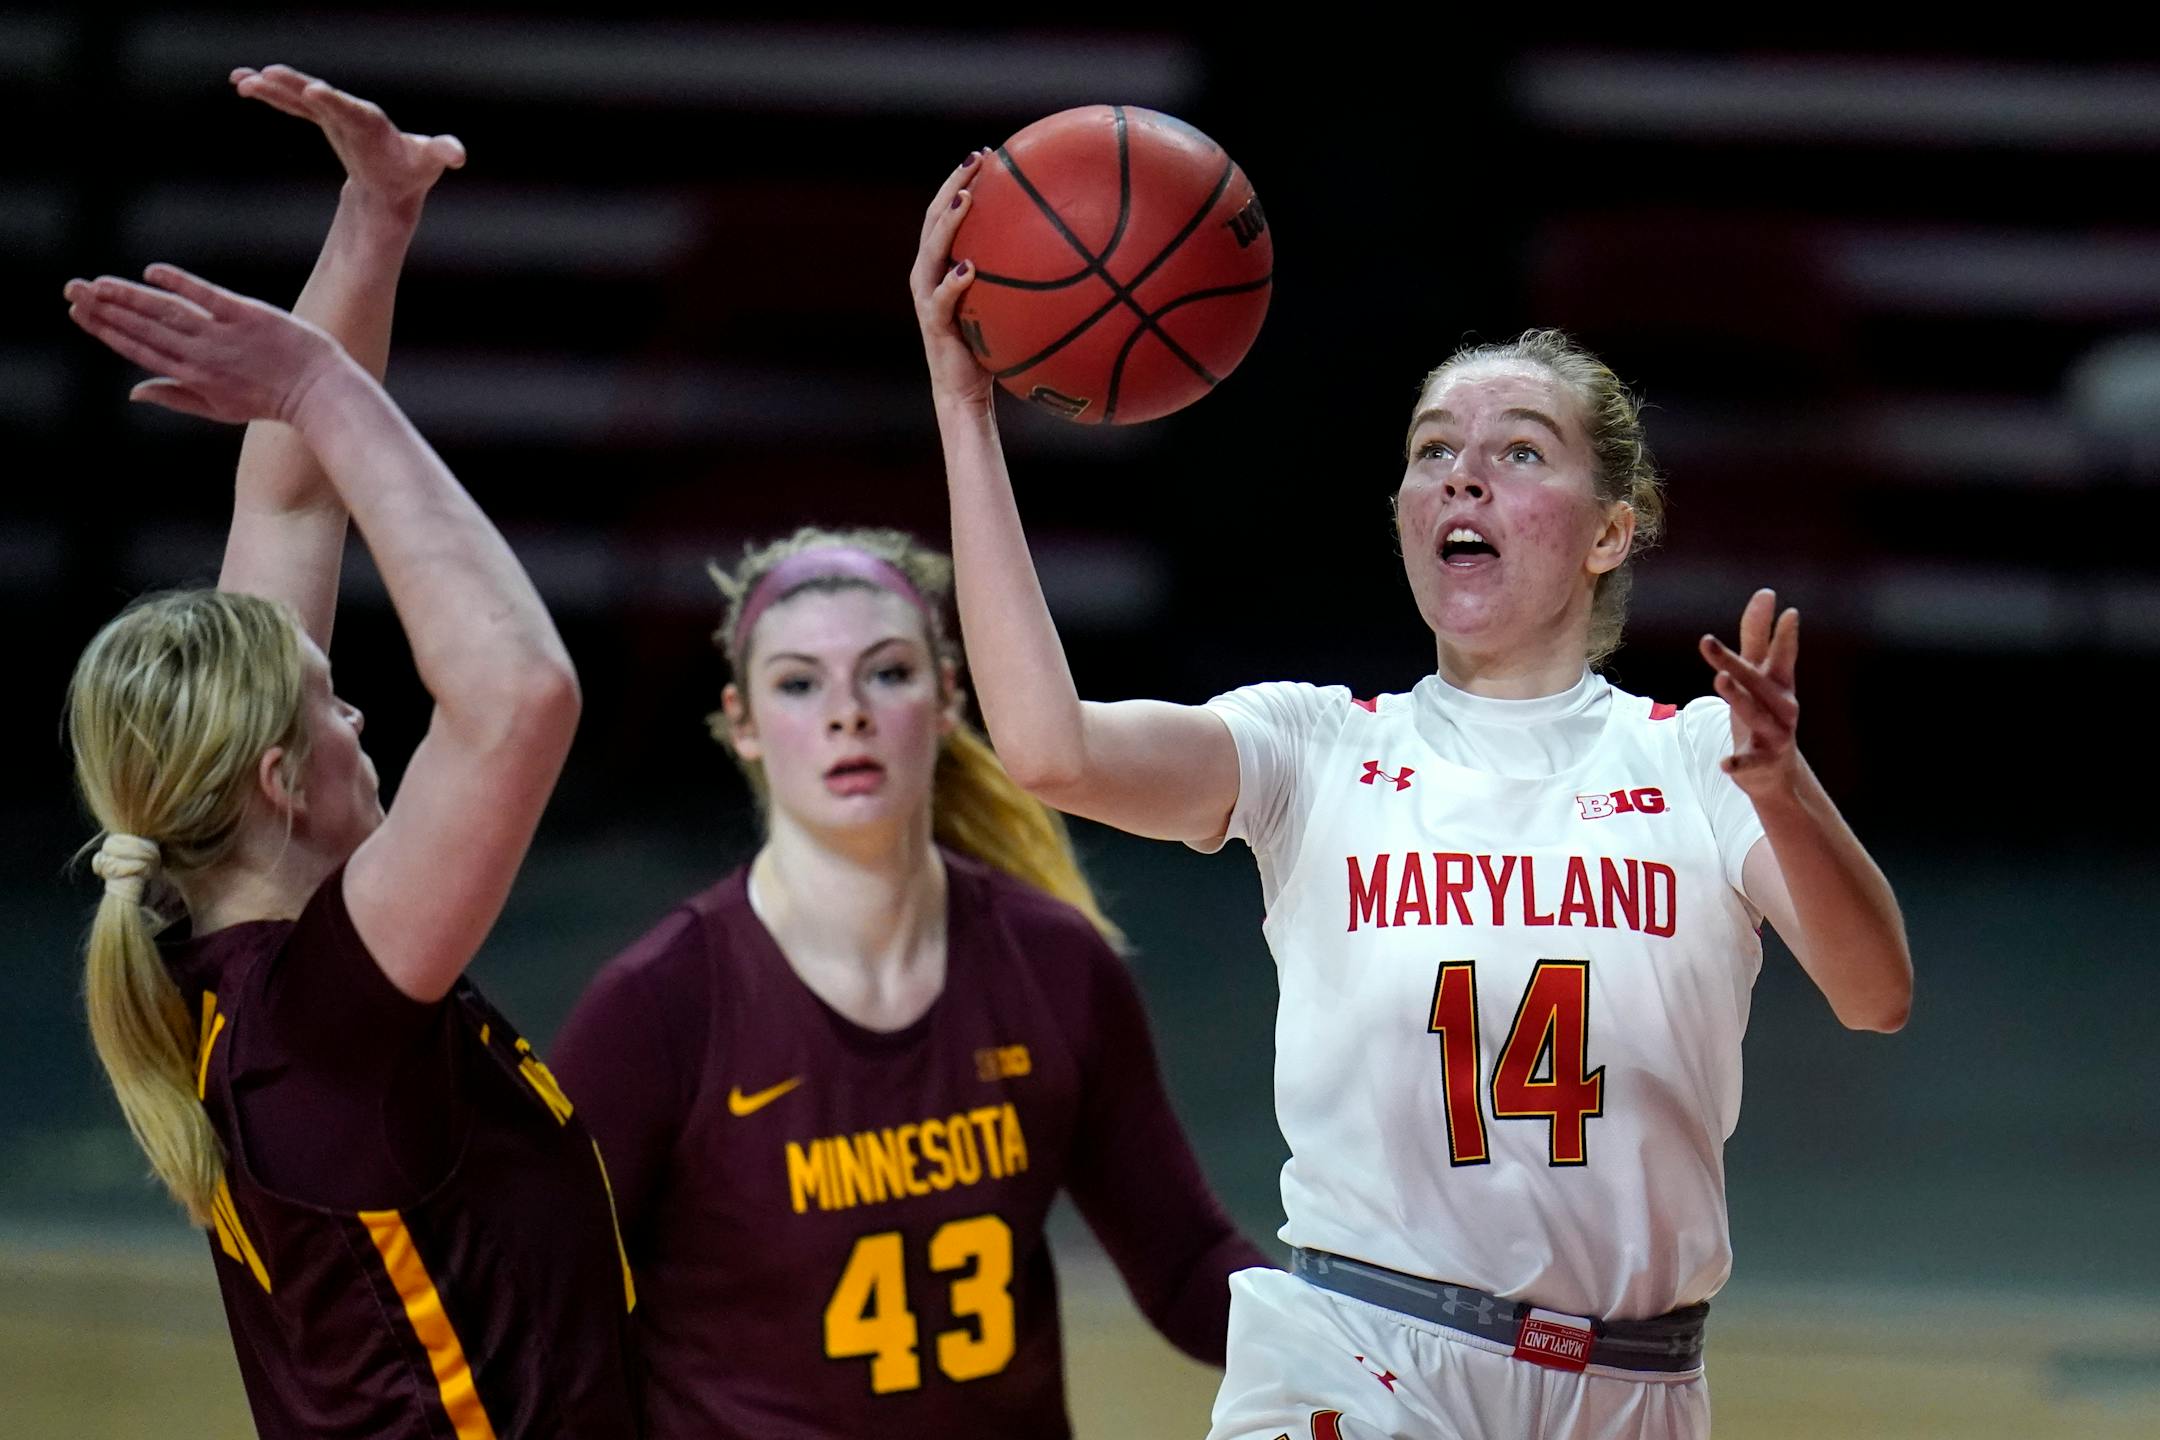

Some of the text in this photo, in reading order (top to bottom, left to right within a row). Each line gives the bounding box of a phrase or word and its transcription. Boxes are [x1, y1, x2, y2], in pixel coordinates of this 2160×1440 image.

[1347, 852, 1677, 938] MARYLAND
[1428, 959, 1605, 1167] 14
[785, 1102, 1029, 1214] MINNESOTA
[824, 1214, 1016, 1394] 43
[1524, 1331, 1585, 1358] MARYLAND
